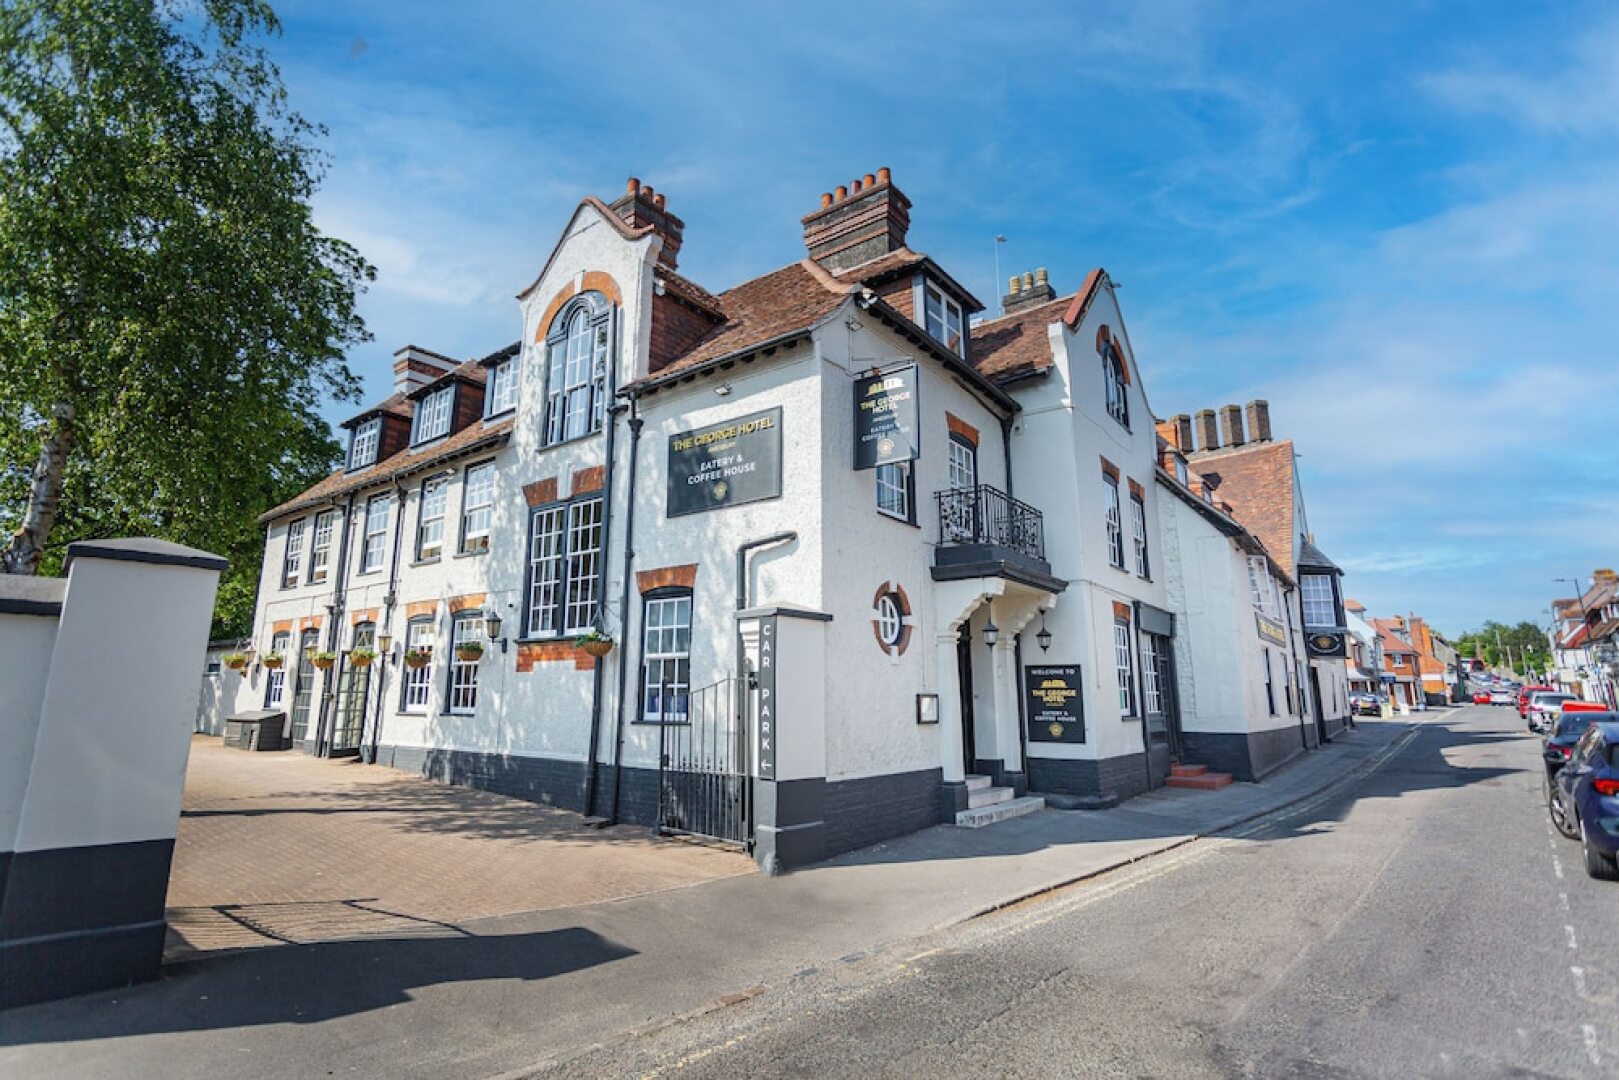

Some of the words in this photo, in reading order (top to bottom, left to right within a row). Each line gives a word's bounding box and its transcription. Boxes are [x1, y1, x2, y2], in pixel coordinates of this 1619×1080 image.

[673, 437, 694, 452] THE
[694, 426, 737, 447] GEORGE
[737, 416, 774, 436] HOTEL
[687, 469, 721, 485] COFFEE
[723, 461, 757, 477] HOUSE
[700, 455, 735, 472] EATERY
[736, 453, 743, 463] &
[762, 624, 772, 668] CAR
[761, 689, 771, 751] PARK
